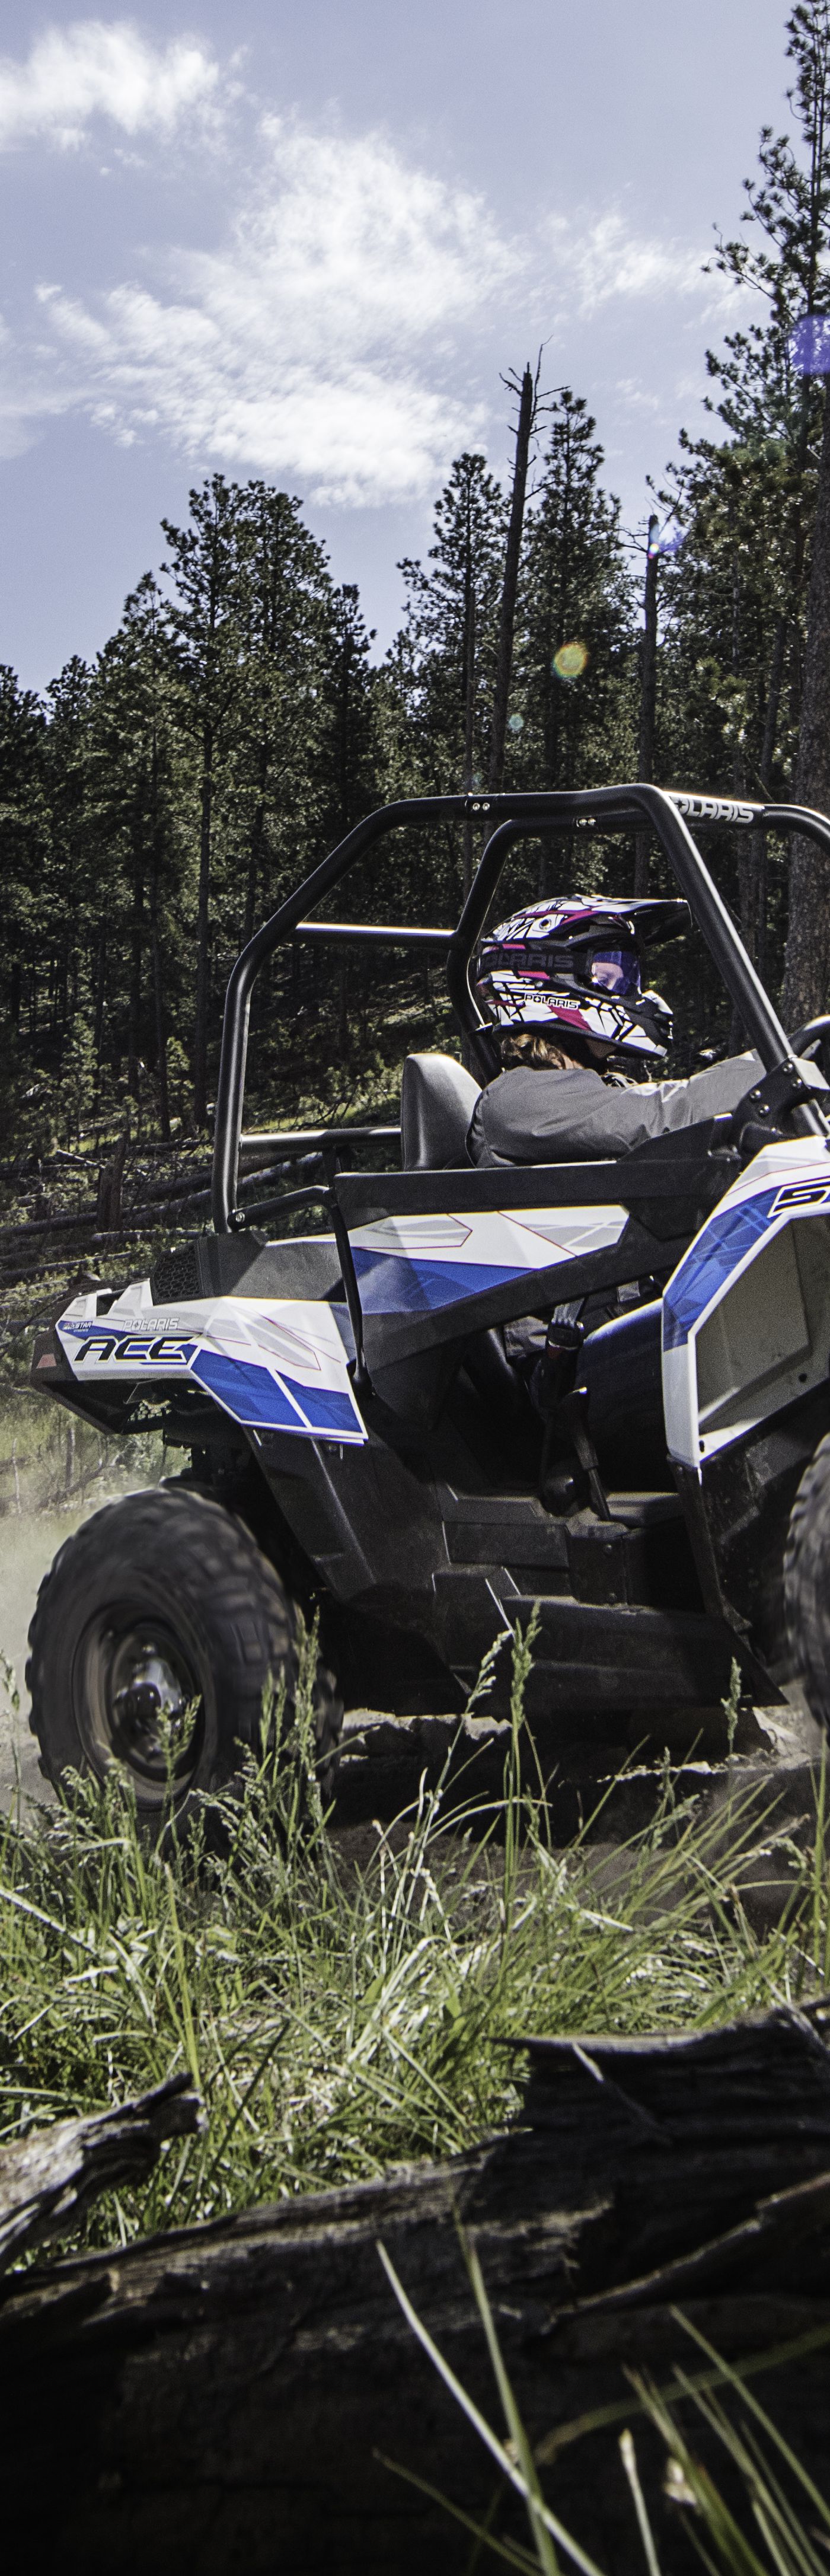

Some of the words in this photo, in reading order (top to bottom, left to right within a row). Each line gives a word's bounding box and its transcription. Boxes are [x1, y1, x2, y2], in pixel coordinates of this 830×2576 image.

[669, 796, 754, 824] OLARIS
[484, 952, 574, 969] OLARIS
[525, 993, 579, 1010] POLARIS
[123, 1318, 179, 1331] POLARIS
[74, 1335, 194, 1362] ACE
